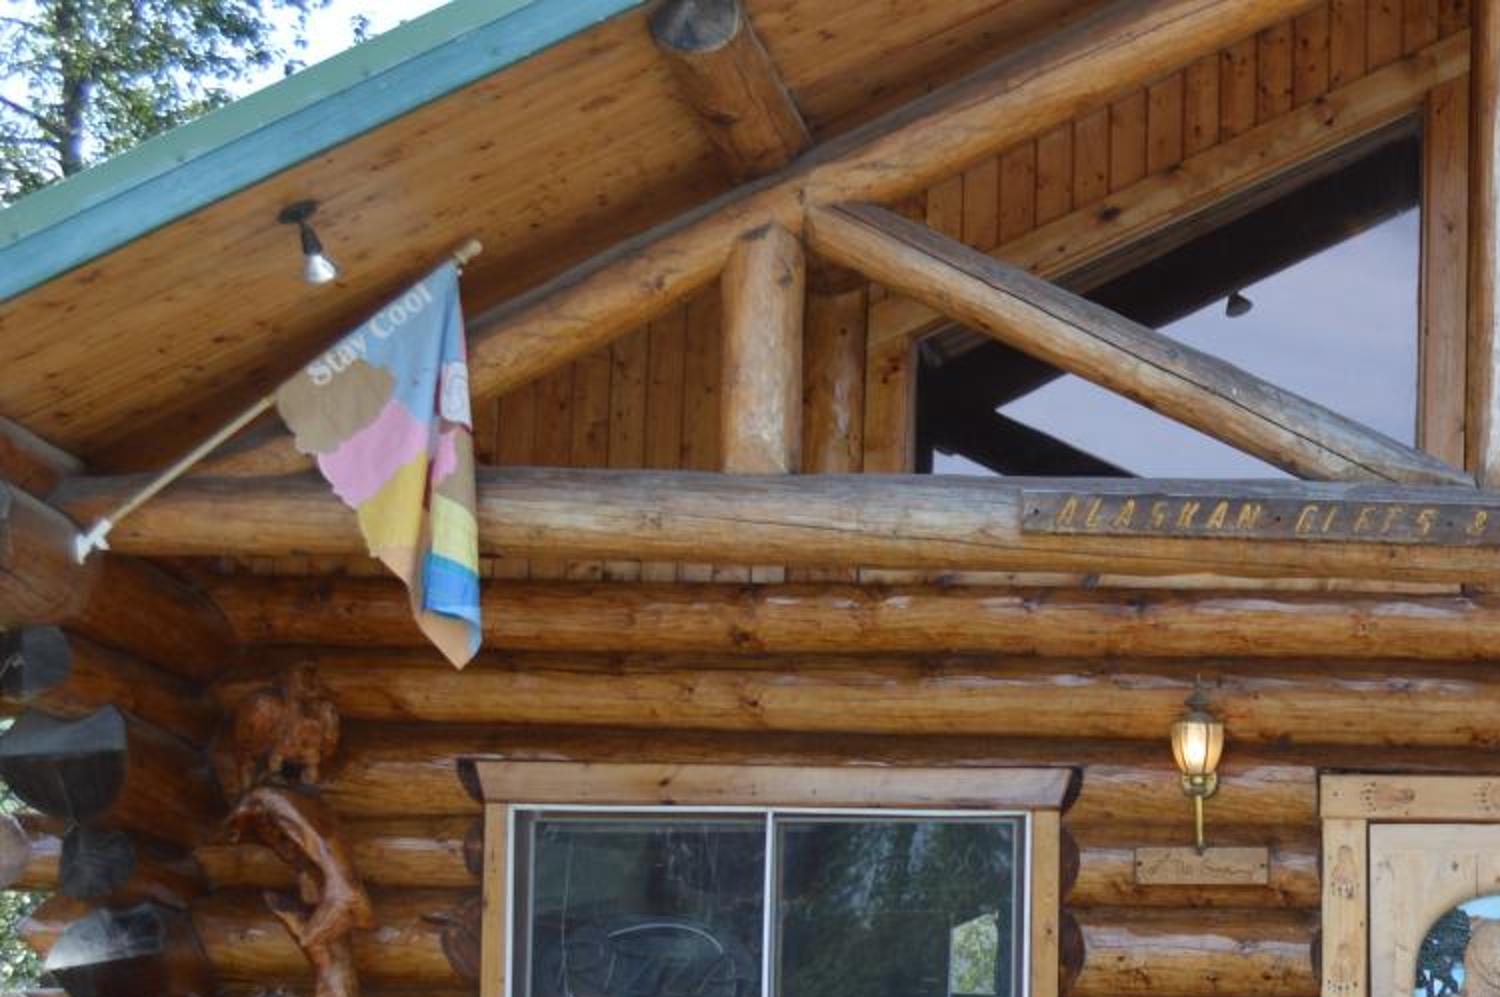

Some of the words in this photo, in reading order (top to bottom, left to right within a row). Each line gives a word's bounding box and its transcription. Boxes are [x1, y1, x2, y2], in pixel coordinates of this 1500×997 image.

[307, 333, 367, 385] Stay
[370, 284, 432, 338] Cool
[1055, 494, 1260, 530] ALASKAN
[1294, 502, 1441, 536] GIFTS
